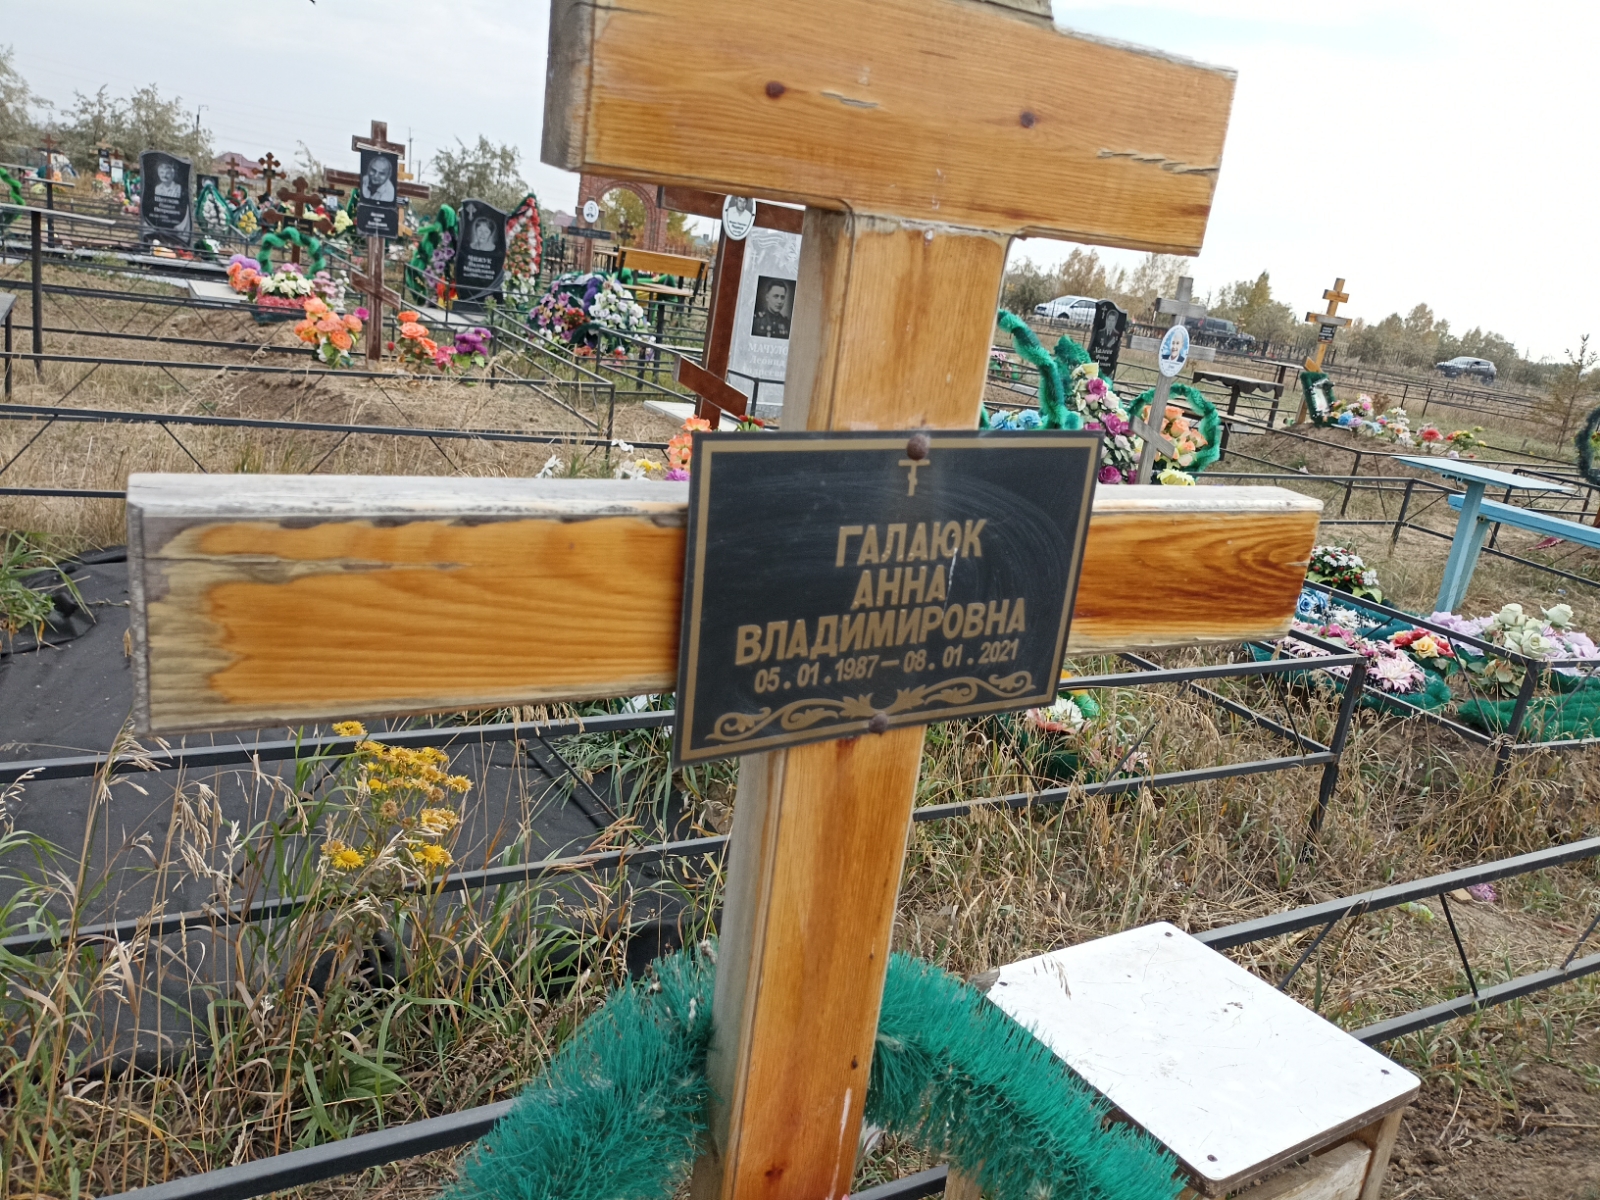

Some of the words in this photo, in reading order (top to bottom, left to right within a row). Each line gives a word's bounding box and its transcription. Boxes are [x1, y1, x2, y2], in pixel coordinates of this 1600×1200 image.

[835, 518, 987, 568] ГАЛАЮК
[850, 564, 946, 610] АННА
[735, 597, 1026, 666] ВЛАДИМИРОВНА
